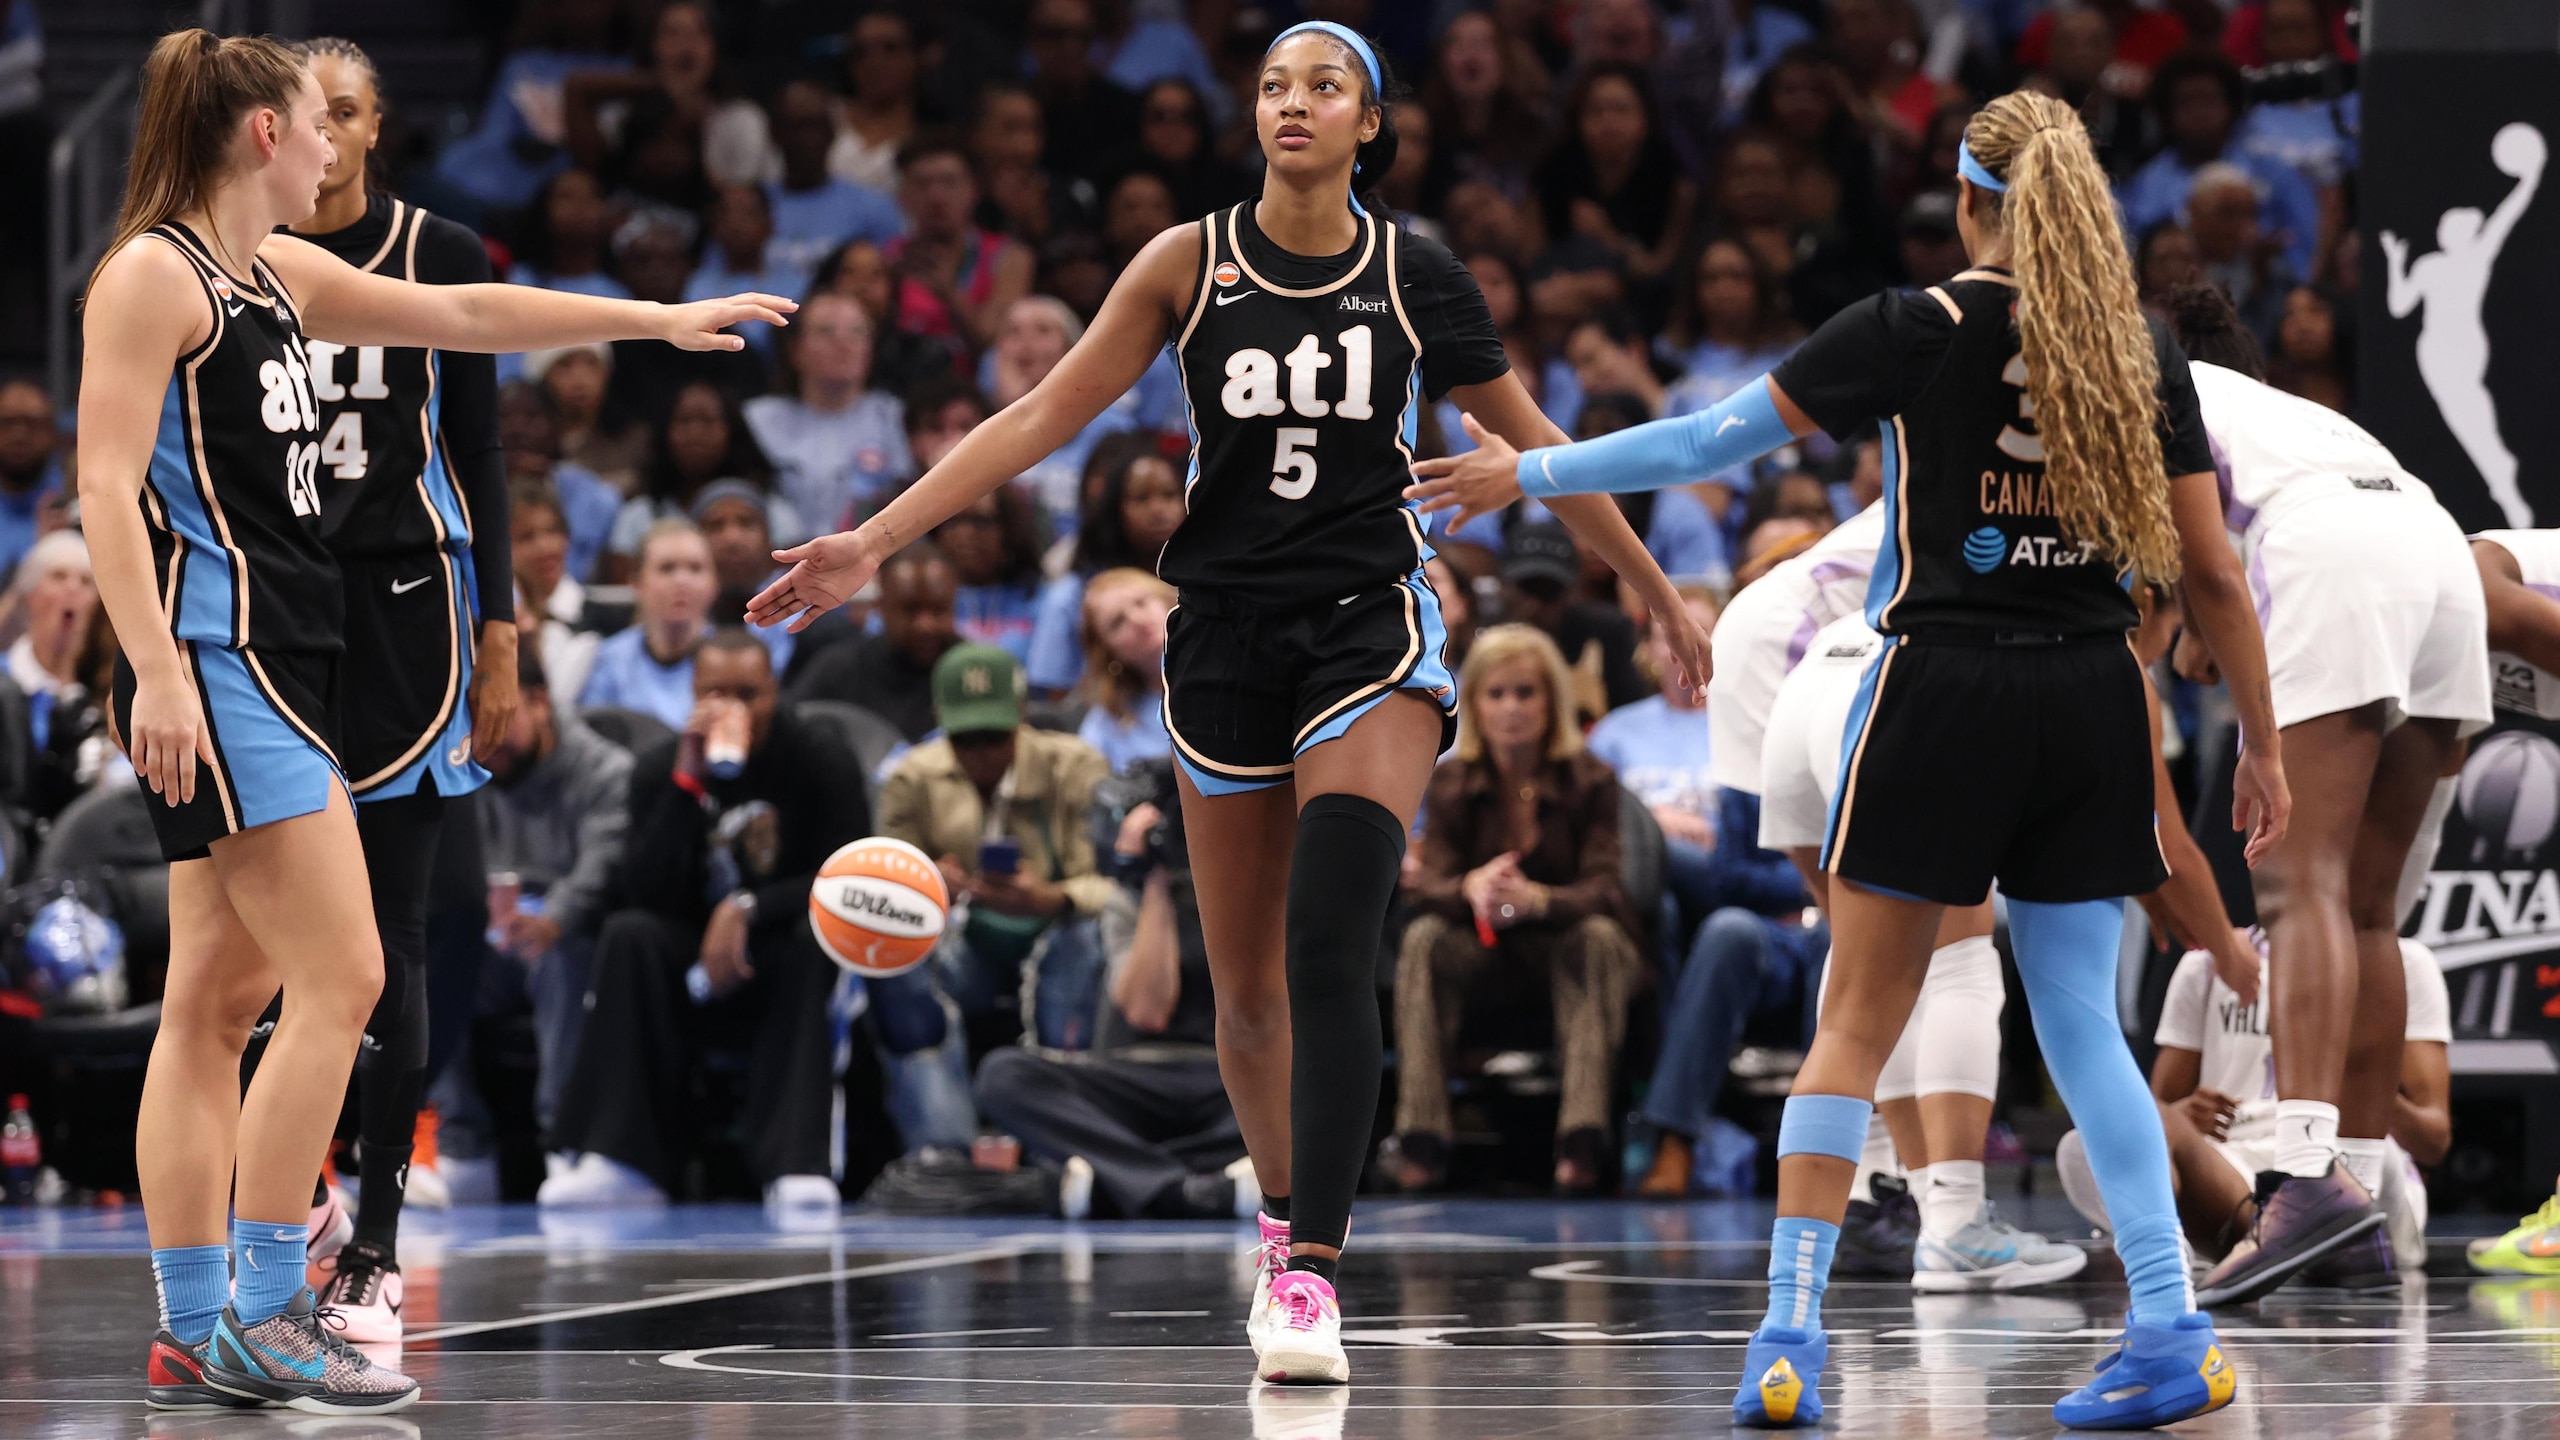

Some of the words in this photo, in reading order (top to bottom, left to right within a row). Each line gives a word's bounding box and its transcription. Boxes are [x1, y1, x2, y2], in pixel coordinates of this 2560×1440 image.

[1338, 295, 1388, 314] Albert
[304, 338, 391, 402] tl
[1221, 324, 1374, 421] atl
[320, 411, 369, 480] 4
[1268, 427, 1319, 500] 5
[285, 439, 322, 518] 20
[1979, 470, 2062, 518] CANA
[2009, 535, 2100, 568] AT&T
[841, 884, 926, 928] Wilson
[2416, 868, 2560, 946] INA
[2219, 1000, 2271, 1035] VAL
